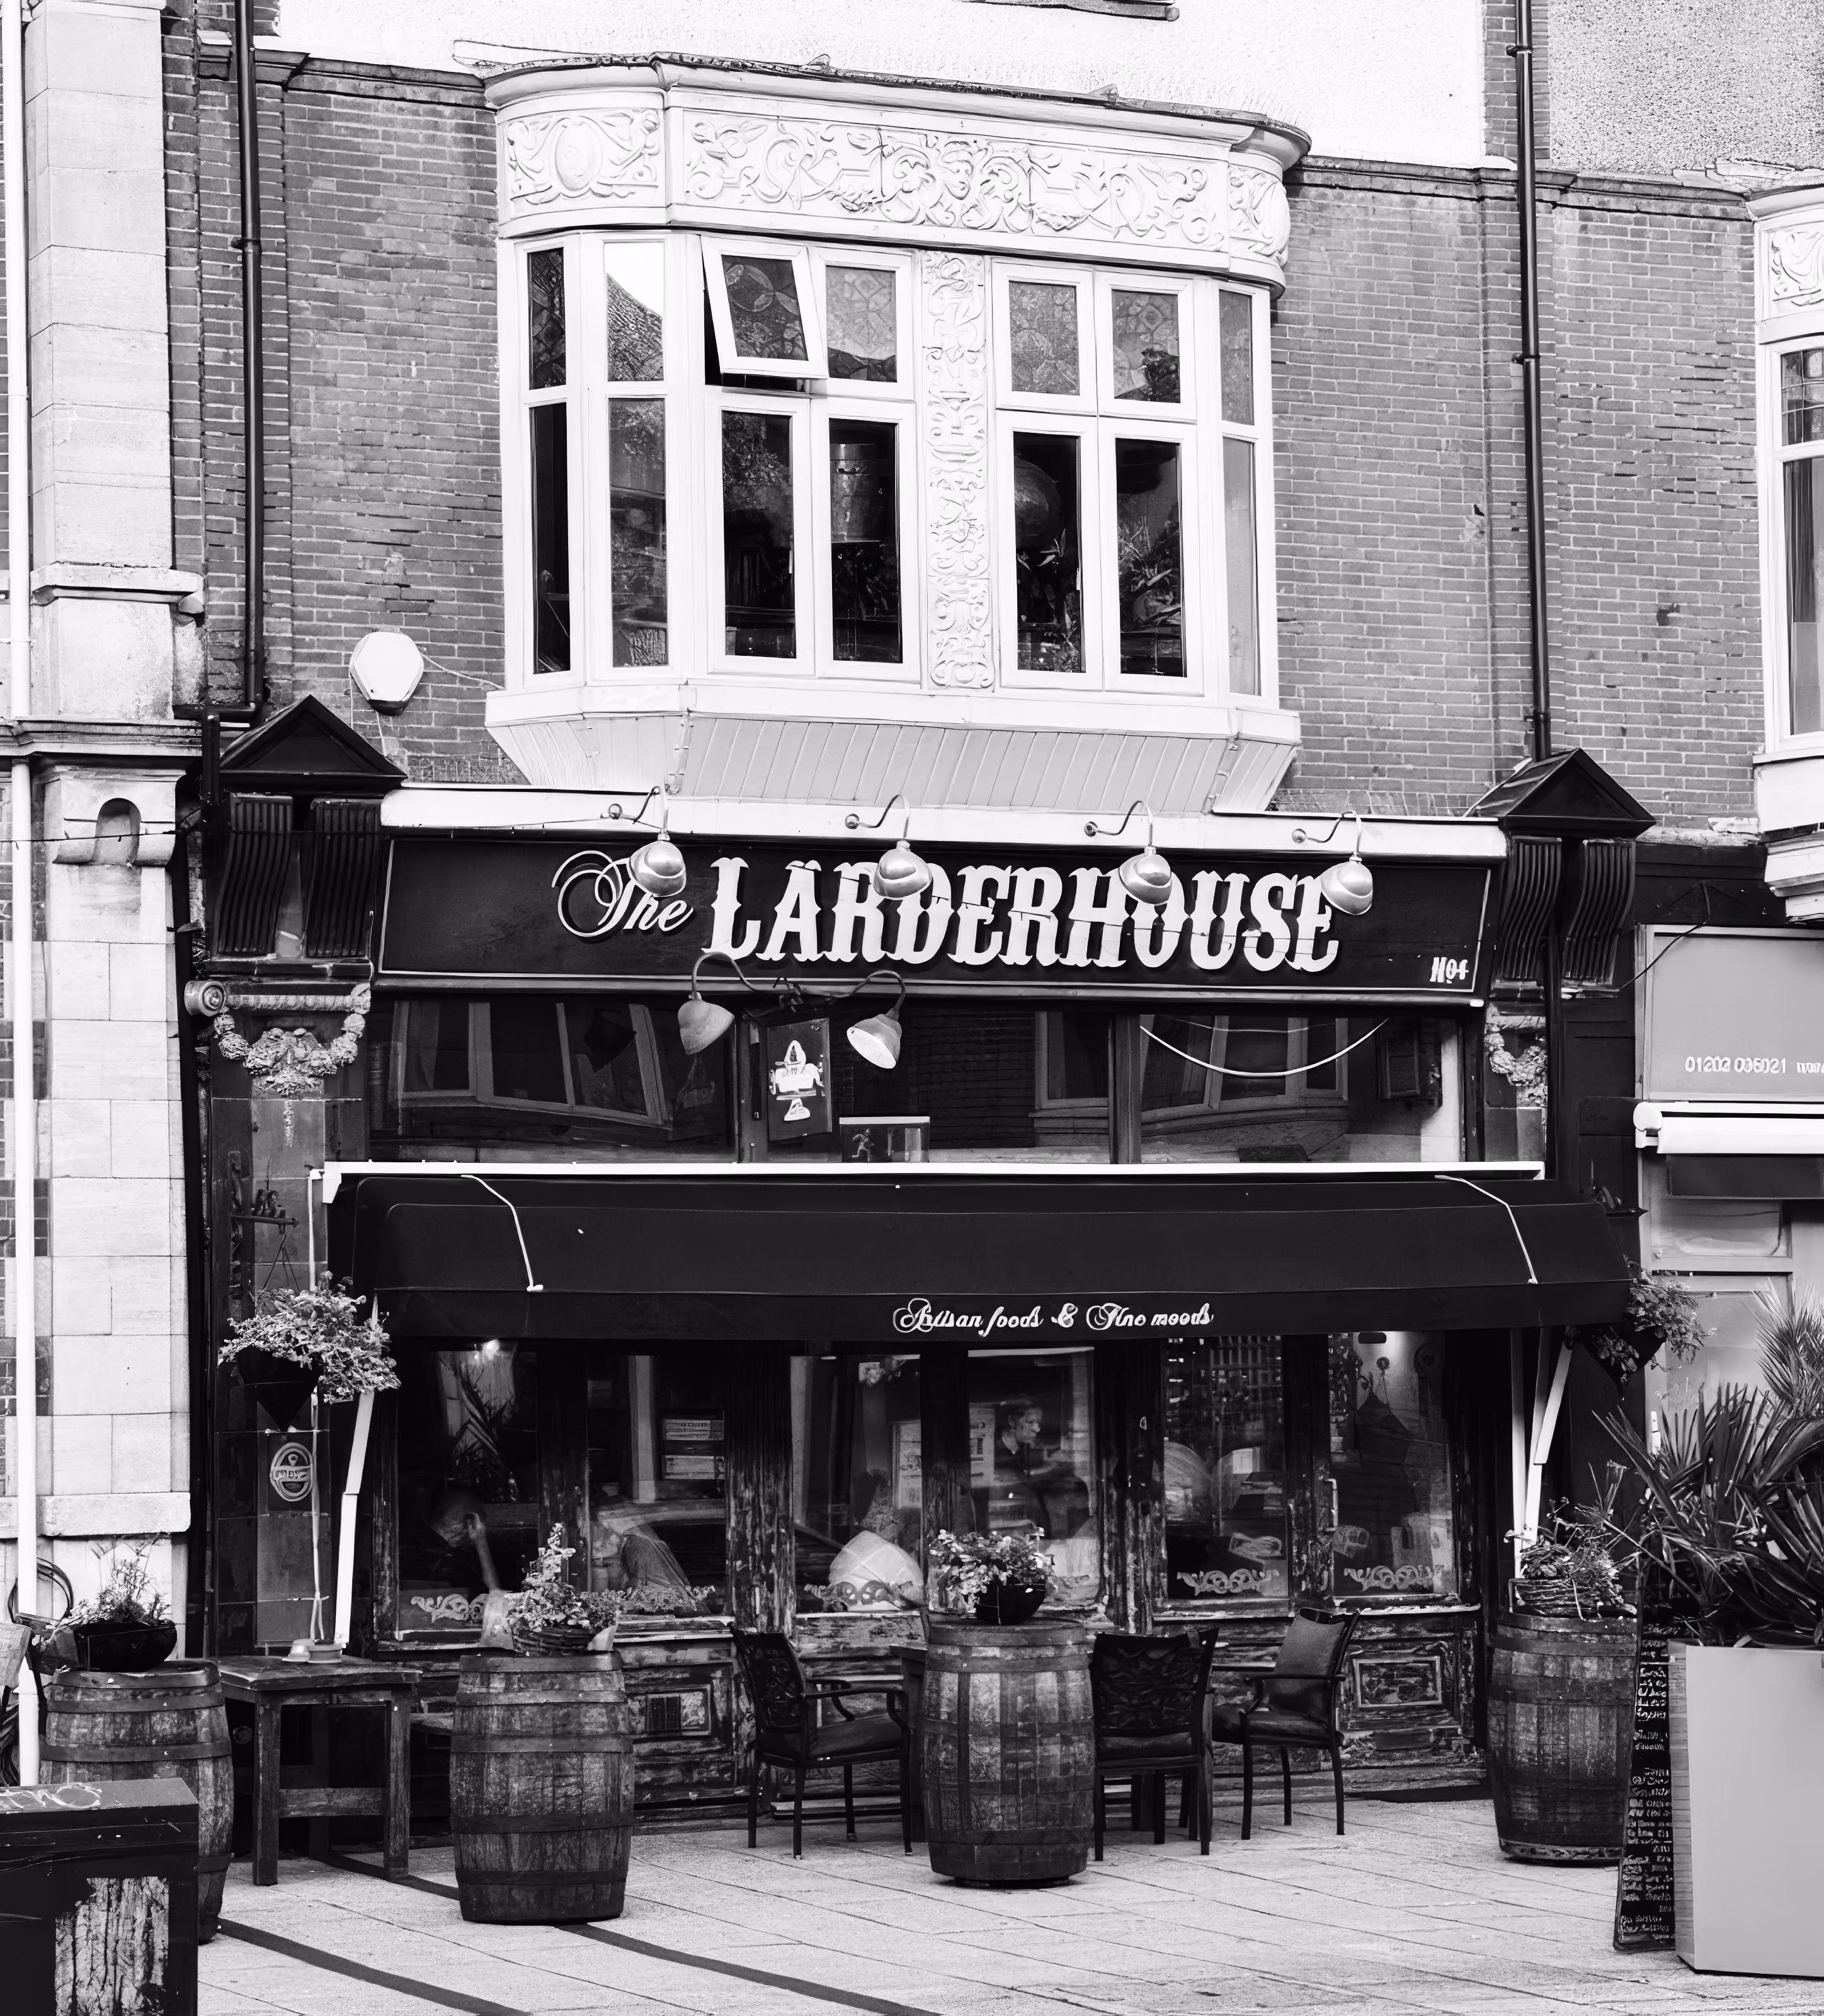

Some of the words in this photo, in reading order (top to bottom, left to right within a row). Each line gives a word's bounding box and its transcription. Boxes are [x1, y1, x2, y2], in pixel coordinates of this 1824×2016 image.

[552, 850, 693, 937] The
[700, 857, 1339, 972] LARDERHOUSE
[1685, 1056, 1731, 1072] 01202
[893, 1298, 983, 1333] Artisan
[978, 1305, 1044, 1337] foods
[1051, 1302, 1078, 1328] &
[1151, 1302, 1214, 1326] moods
